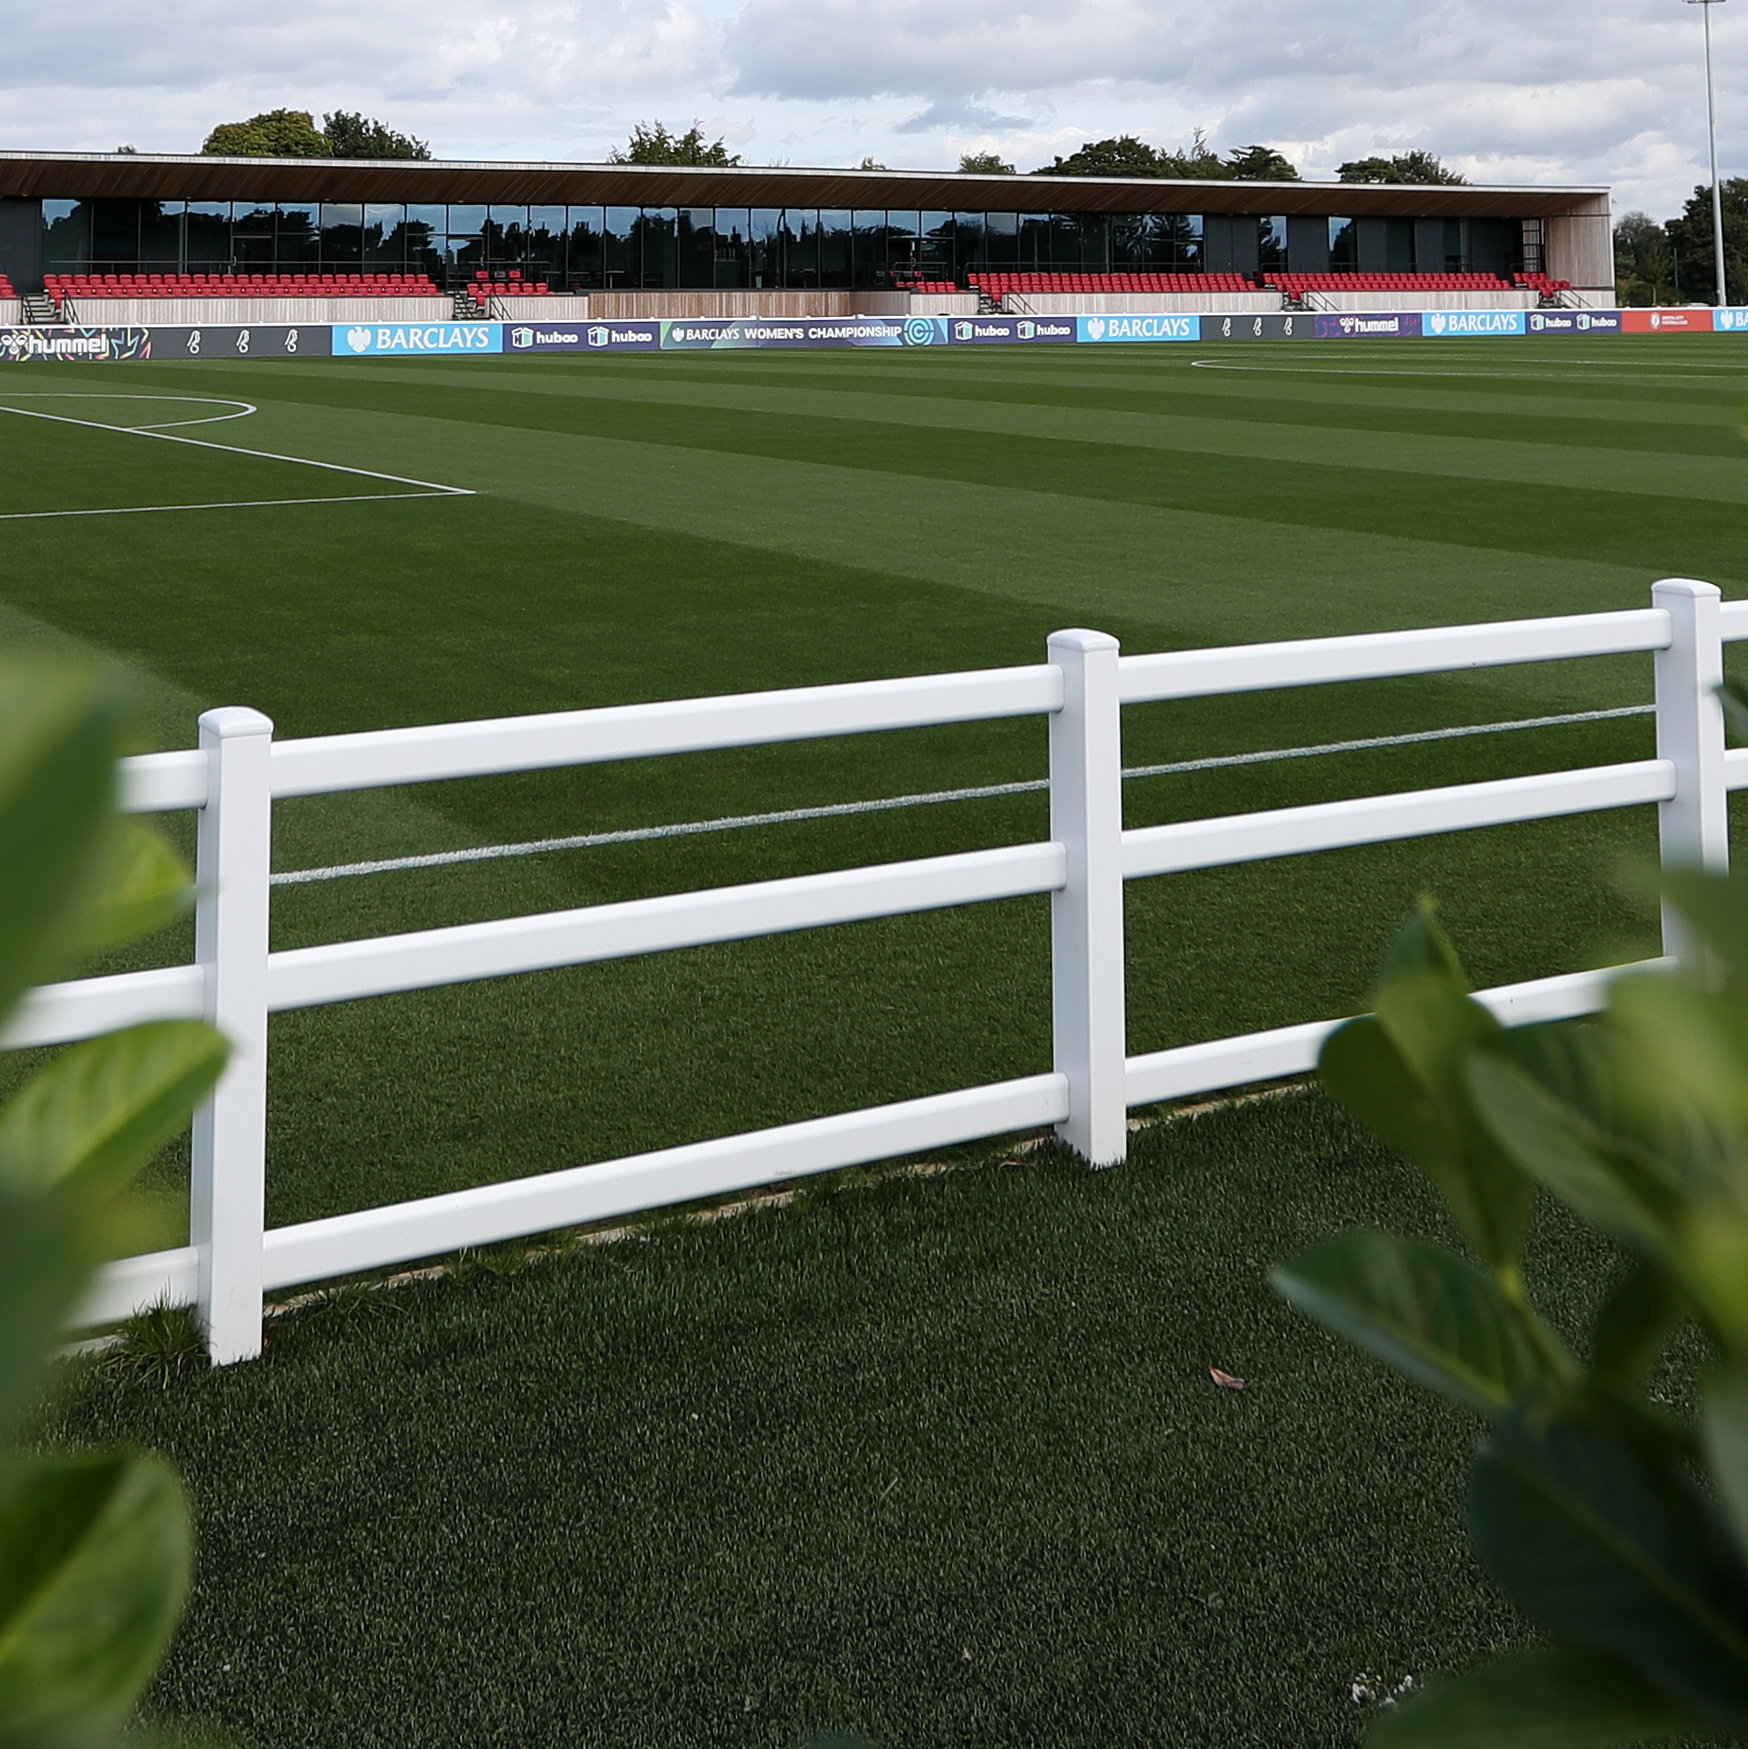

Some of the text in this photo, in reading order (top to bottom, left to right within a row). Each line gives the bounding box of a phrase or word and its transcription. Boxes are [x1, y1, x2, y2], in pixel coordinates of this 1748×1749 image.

[1108, 318, 1190, 337] BARCLAYS
[1354, 317, 1399, 332] hummel
[1449, 313, 1518, 331] BARCLAYS
[1545, 317, 1572, 328] huboo
[1591, 316, 1617, 327] huboo
[612, 330, 652, 342] huboo
[686, 326, 902, 340] BARCLAYS WOMEN'S CHAMPIONSHIP
[975, 325, 1010, 337] huboo
[1037, 324, 1071, 336] huboo
[28, 333, 108, 354] hummel
[376, 327, 489, 349] BARCLAYS
[537, 331, 578, 343] huboo
